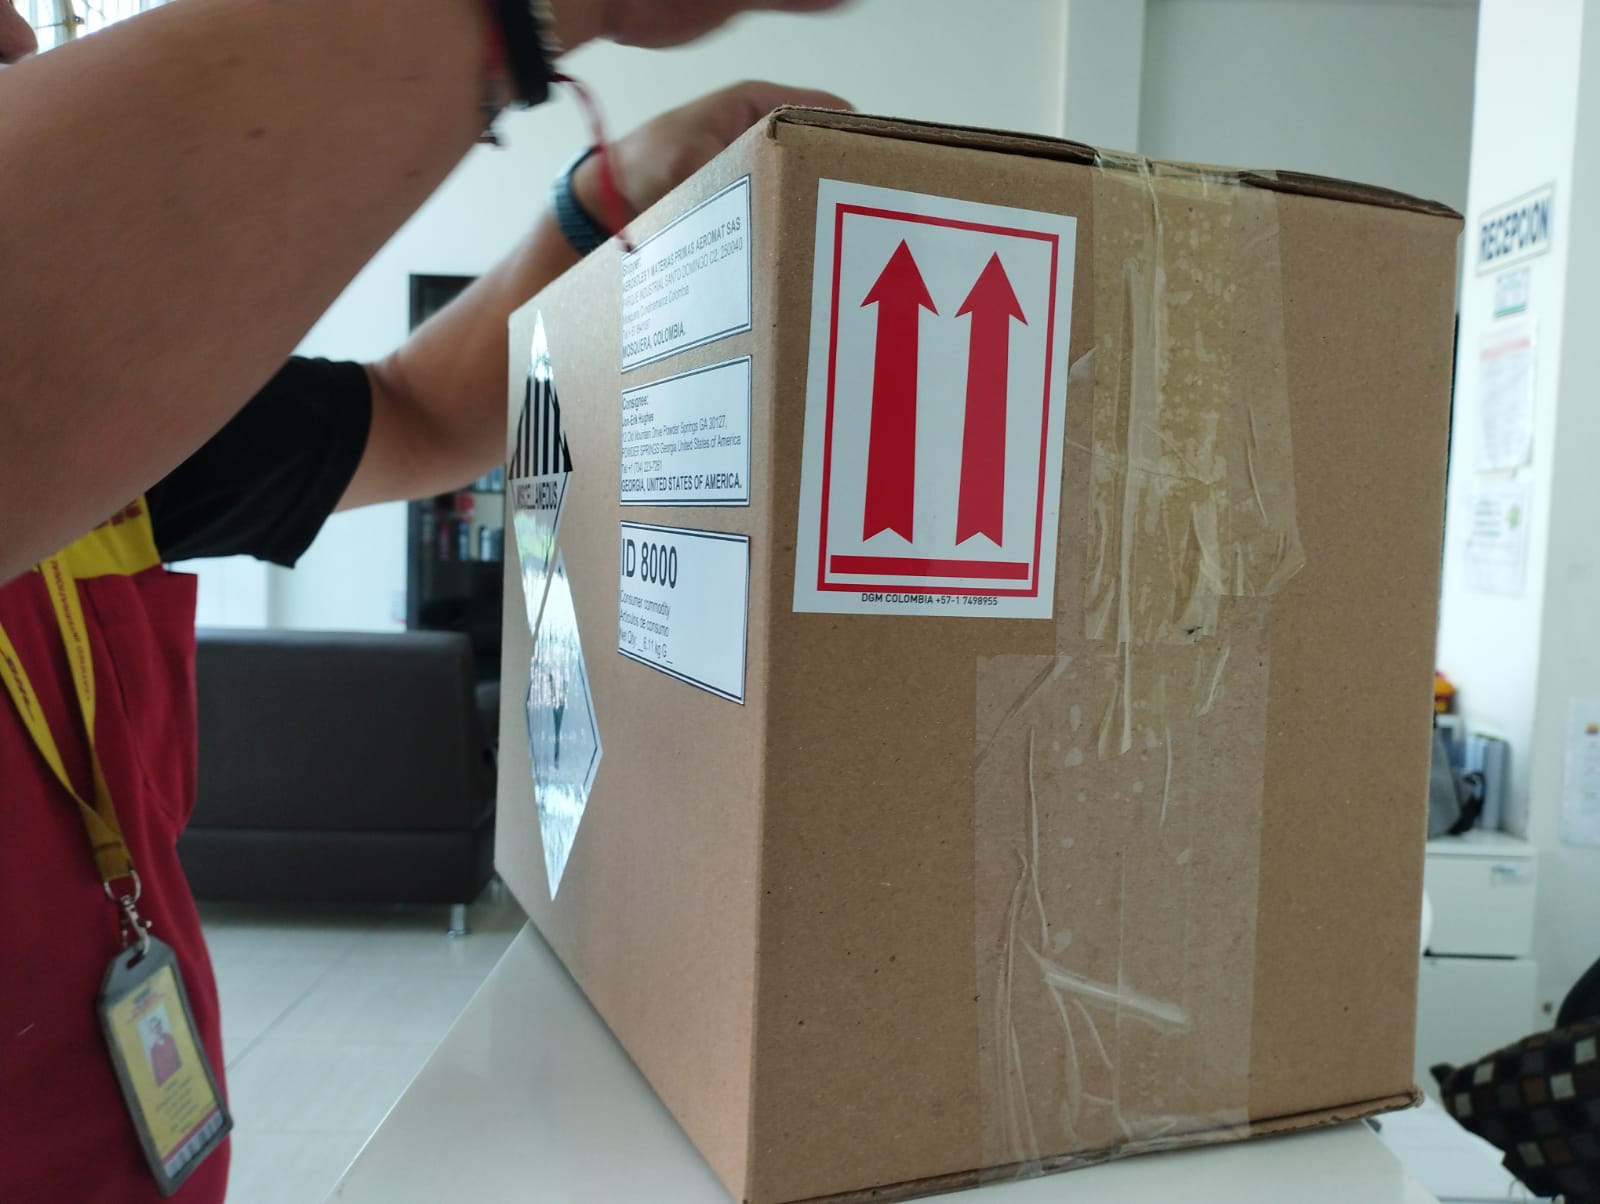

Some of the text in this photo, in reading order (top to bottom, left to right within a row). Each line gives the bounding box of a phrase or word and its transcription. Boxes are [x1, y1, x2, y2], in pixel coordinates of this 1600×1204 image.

[696, 224, 725, 252] AEROMAT
[726, 217, 741, 235] SAS
[665, 267, 681, 287] SANTO
[682, 253, 708, 278] DOMINGO
[653, 321, 686, 346] COLOMBIA.
[622, 395, 649, 411] Consignee:
[680, 420, 698, 437] Springs
[699, 418, 708, 431] GA
[660, 442, 677, 456] Georgia
[678, 439, 693, 452] United
[694, 437, 710, 450] States
[717, 434, 741, 446] America
[646, 477, 667, 491] UNITED
[668, 475, 693, 491] STATES
[694, 474, 704, 489] OF
[704, 472, 742, 489] AMERICA.
[621, 538, 678, 589] ID 8000
[620, 590, 670, 620] Consumer commodity
[861, 593, 998, 606] DGM COLOMBIA +57-1 7498955
[646, 620, 670, 637] consumo
